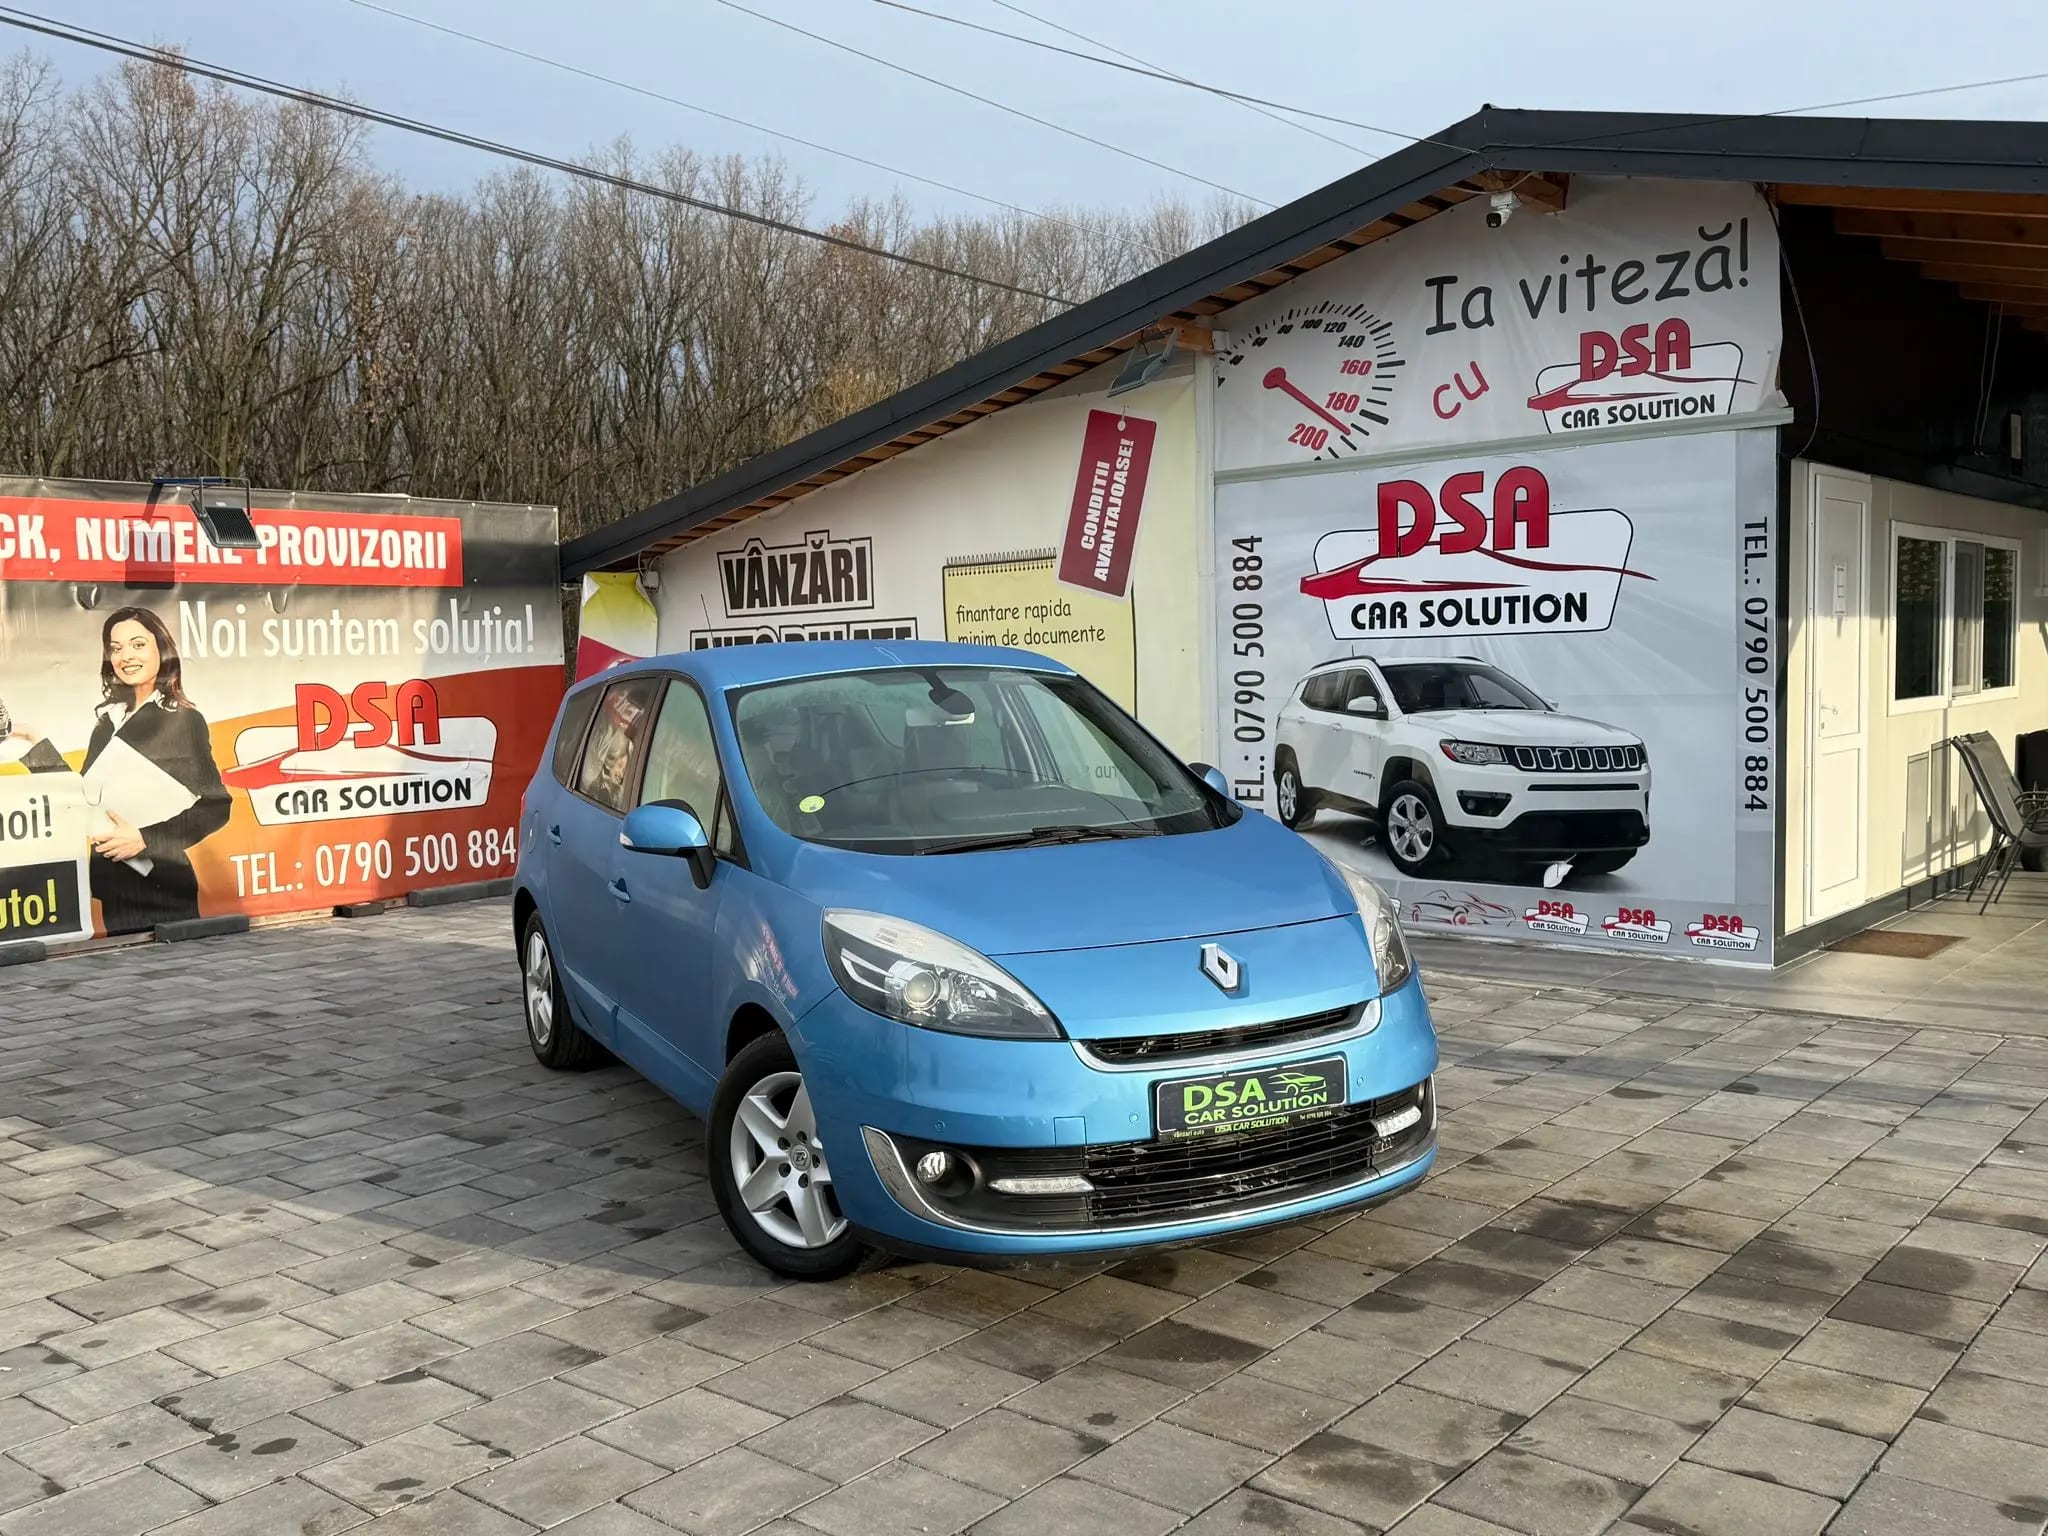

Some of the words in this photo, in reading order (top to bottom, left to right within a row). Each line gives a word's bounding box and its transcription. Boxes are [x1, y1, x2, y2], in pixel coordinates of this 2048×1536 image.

[1425, 275, 1495, 335] Ia
[1519, 218, 1749, 319] viteză!
[1301, 319, 1323, 329] 100
[1323, 321, 1347, 333] 120
[1338, 335, 1365, 348] 140
[1339, 359, 1372, 376] 160
[1580, 317, 1691, 382] DSA
[1325, 391, 1360, 413] 180
[1433, 361, 1489, 419] cu
[1561, 408, 1599, 429] CAR
[1607, 394, 1715, 423] SOLUTION
[1287, 423, 1329, 451] 200
[1080, 460, 1110, 550] CONDITII
[1093, 438, 1134, 582] AVANTAJOASE!
[1377, 465, 1550, 559] DSA
[256, 524, 447, 569] PROVIZORII
[1232, 535, 1263, 591] 884
[723, 538, 868, 610] VÂNZĂRI
[179, 601, 247, 658] Noi
[262, 609, 400, 657] suntem
[955, 604, 1020, 624] finantare
[1024, 598, 1072, 623] rapida
[1232, 603, 1265, 657] 500
[1351, 601, 1407, 630] CAR
[1419, 592, 1587, 628] SOLUTION
[1001, 627, 1019, 646] de
[1024, 625, 1106, 645] documente
[1744, 597, 1768, 674] 0790
[295, 679, 441, 752] DSA
[1233, 670, 1266, 743] 0790
[1744, 687, 1768, 743] 500
[275, 790, 329, 816] CAR
[339, 777, 472, 811] SOLUTION
[1744, 755, 1768, 812] 884
[315, 839, 392, 888] 0790
[405, 832, 458, 877] 500
[467, 827, 517, 868] 884
[1538, 900, 1574, 919] DSA
[1547, 924, 1581, 933] SOLUTION
[1618, 908, 1656, 926] DSA
[1703, 914, 1743, 933] DSA
[1628, 931, 1664, 941] SOLUTION
[1713, 938, 1751, 949] SOLUTION
[1183, 1078, 1267, 1112] DSA
[1184, 1108, 1226, 1125] CAR
[1231, 1092, 1328, 1118] SOLUTION
[1214, 1123, 1233, 1134] DSA
[1233, 1121, 1250, 1132] CAR
[1250, 1116, 1289, 1130] SOLUTION
